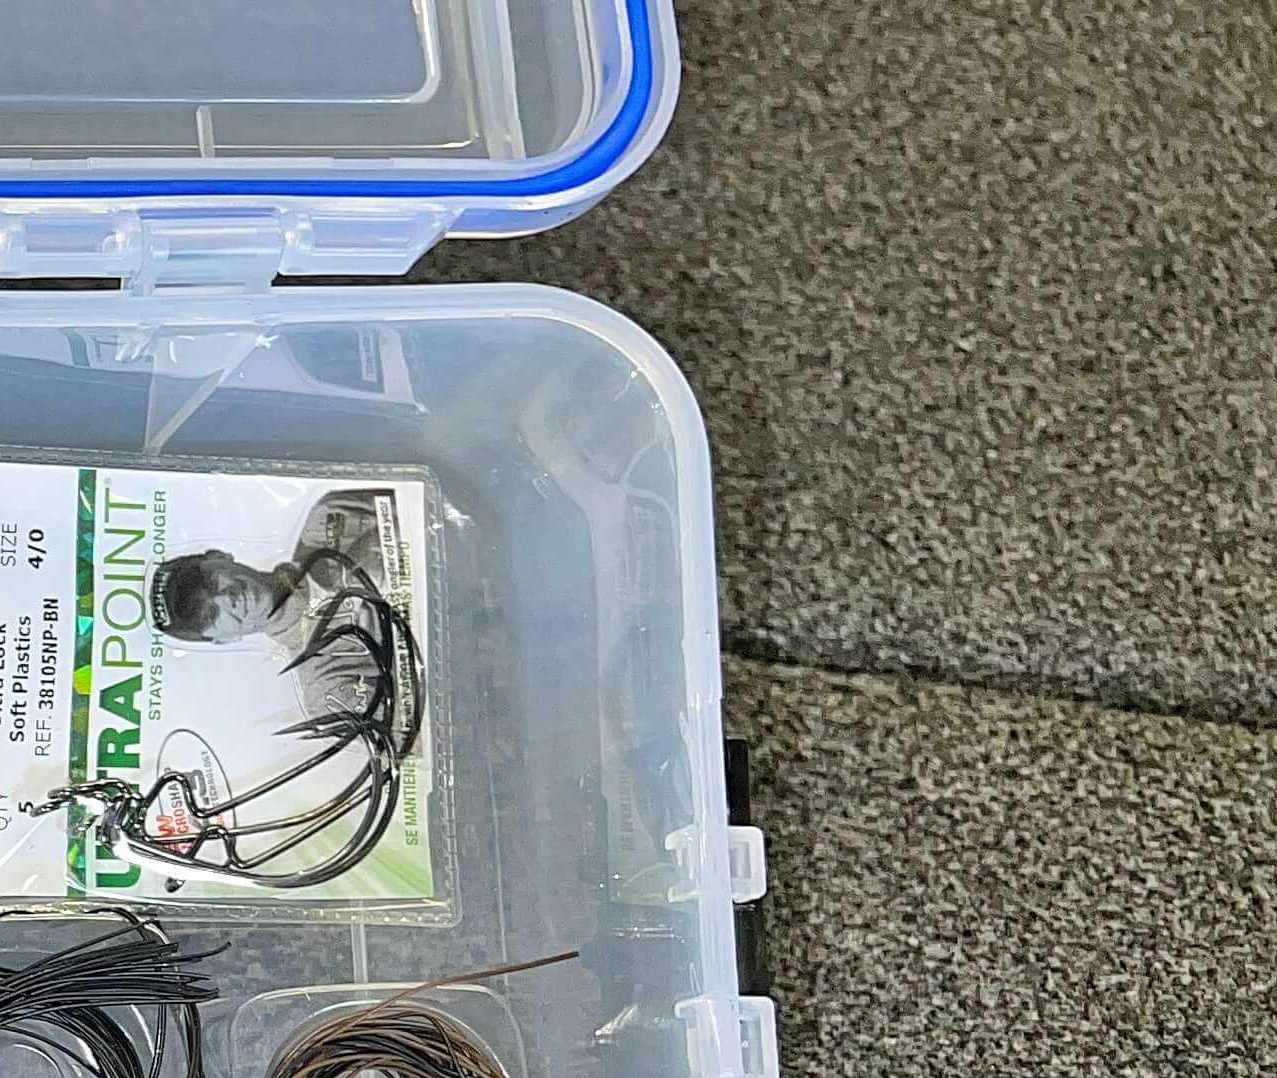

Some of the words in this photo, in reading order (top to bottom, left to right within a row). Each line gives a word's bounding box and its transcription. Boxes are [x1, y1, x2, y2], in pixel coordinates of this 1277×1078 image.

[153, 490, 167, 565] LONGER
[379, 502, 390, 524] year
[0, 522, 18, 567] SIZE
[28, 528, 46, 569] 4/0
[381, 525, 393, 543] the
[383, 543, 395, 556] of
[12, 615, 31, 693] Plastics
[38, 598, 59, 710] 38105NP-BN
[95, 487, 147, 890] UTRAPOINT
[148, 664, 163, 721] STAYS
[9, 701, 27, 742] Soft
[34, 715, 52, 756] REF.
[18, 801, 34, 813] 5
[405, 830, 419, 846] SE
